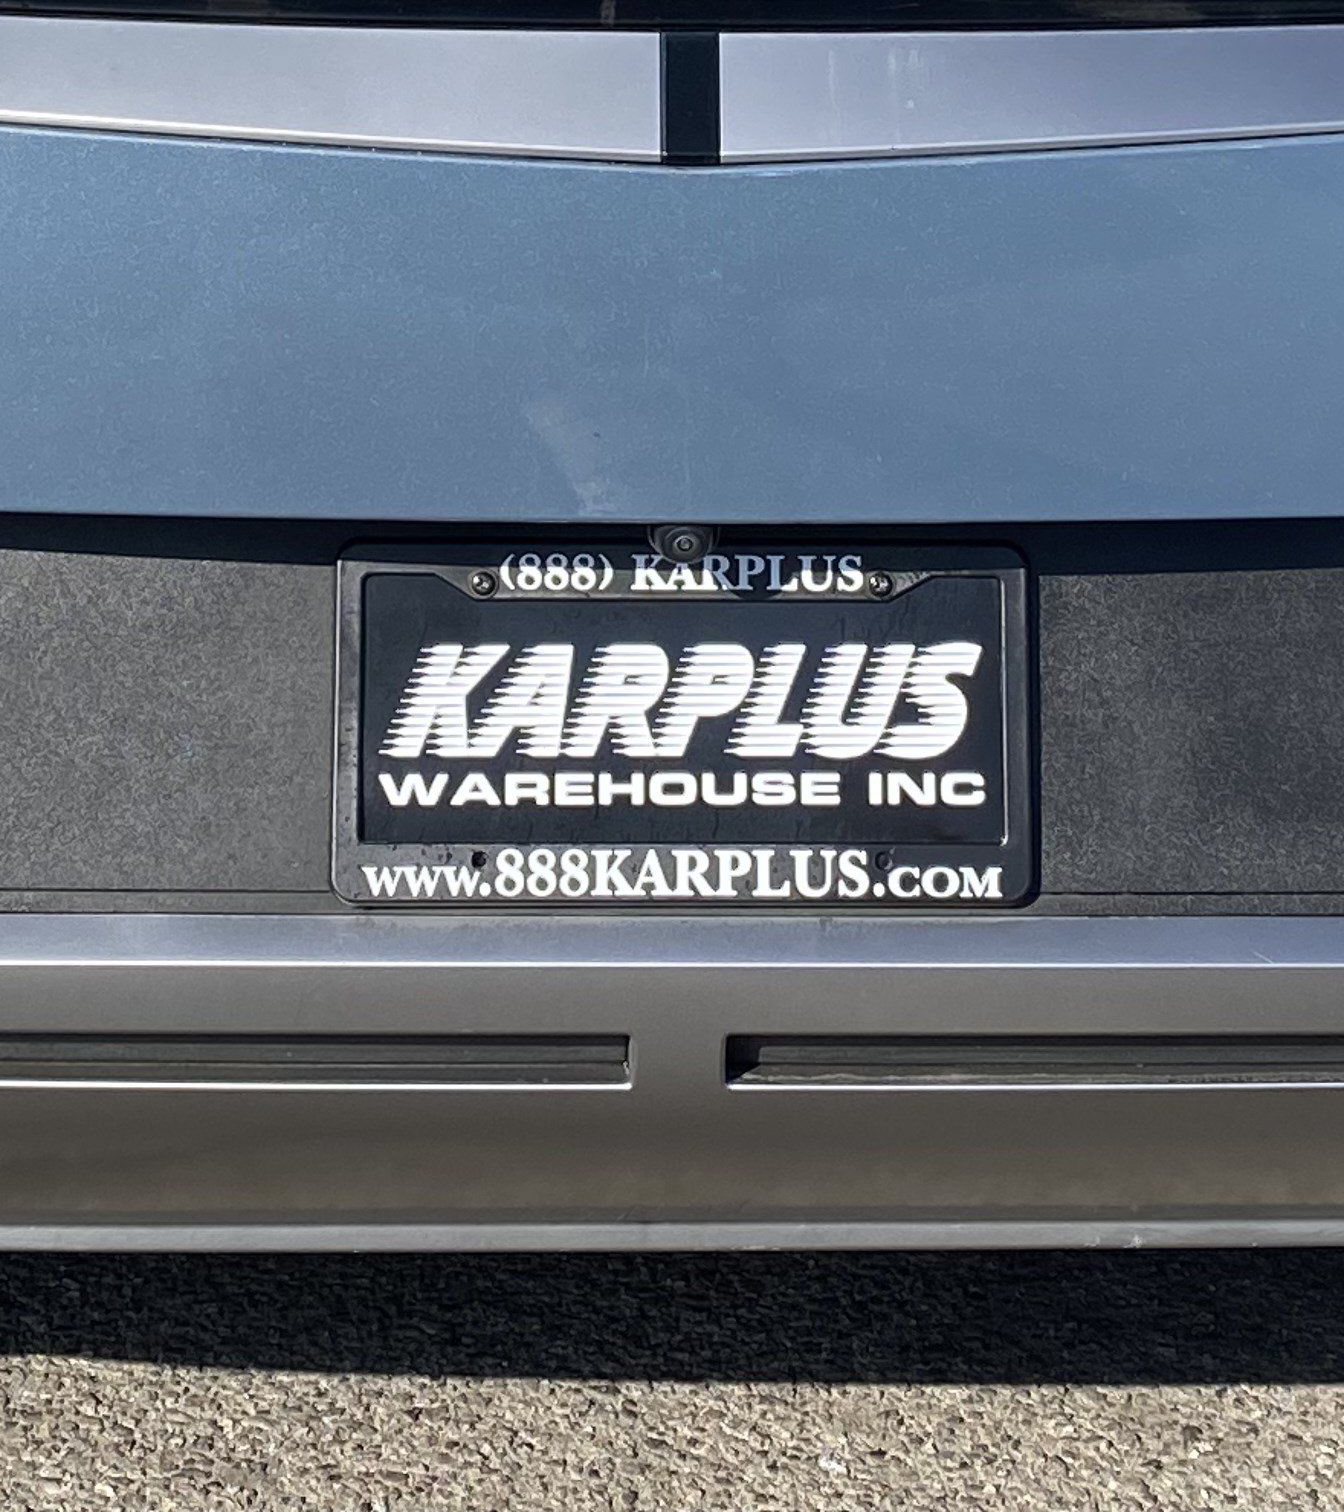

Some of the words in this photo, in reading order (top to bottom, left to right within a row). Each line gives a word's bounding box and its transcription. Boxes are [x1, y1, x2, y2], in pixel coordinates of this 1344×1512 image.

[499, 553, 612, 593] (888)
[630, 553, 865, 593] KARPLUS
[379, 641, 983, 759] KARPLUS
[378, 771, 842, 807] WAREHOUSE
[868, 771, 986, 807] INC
